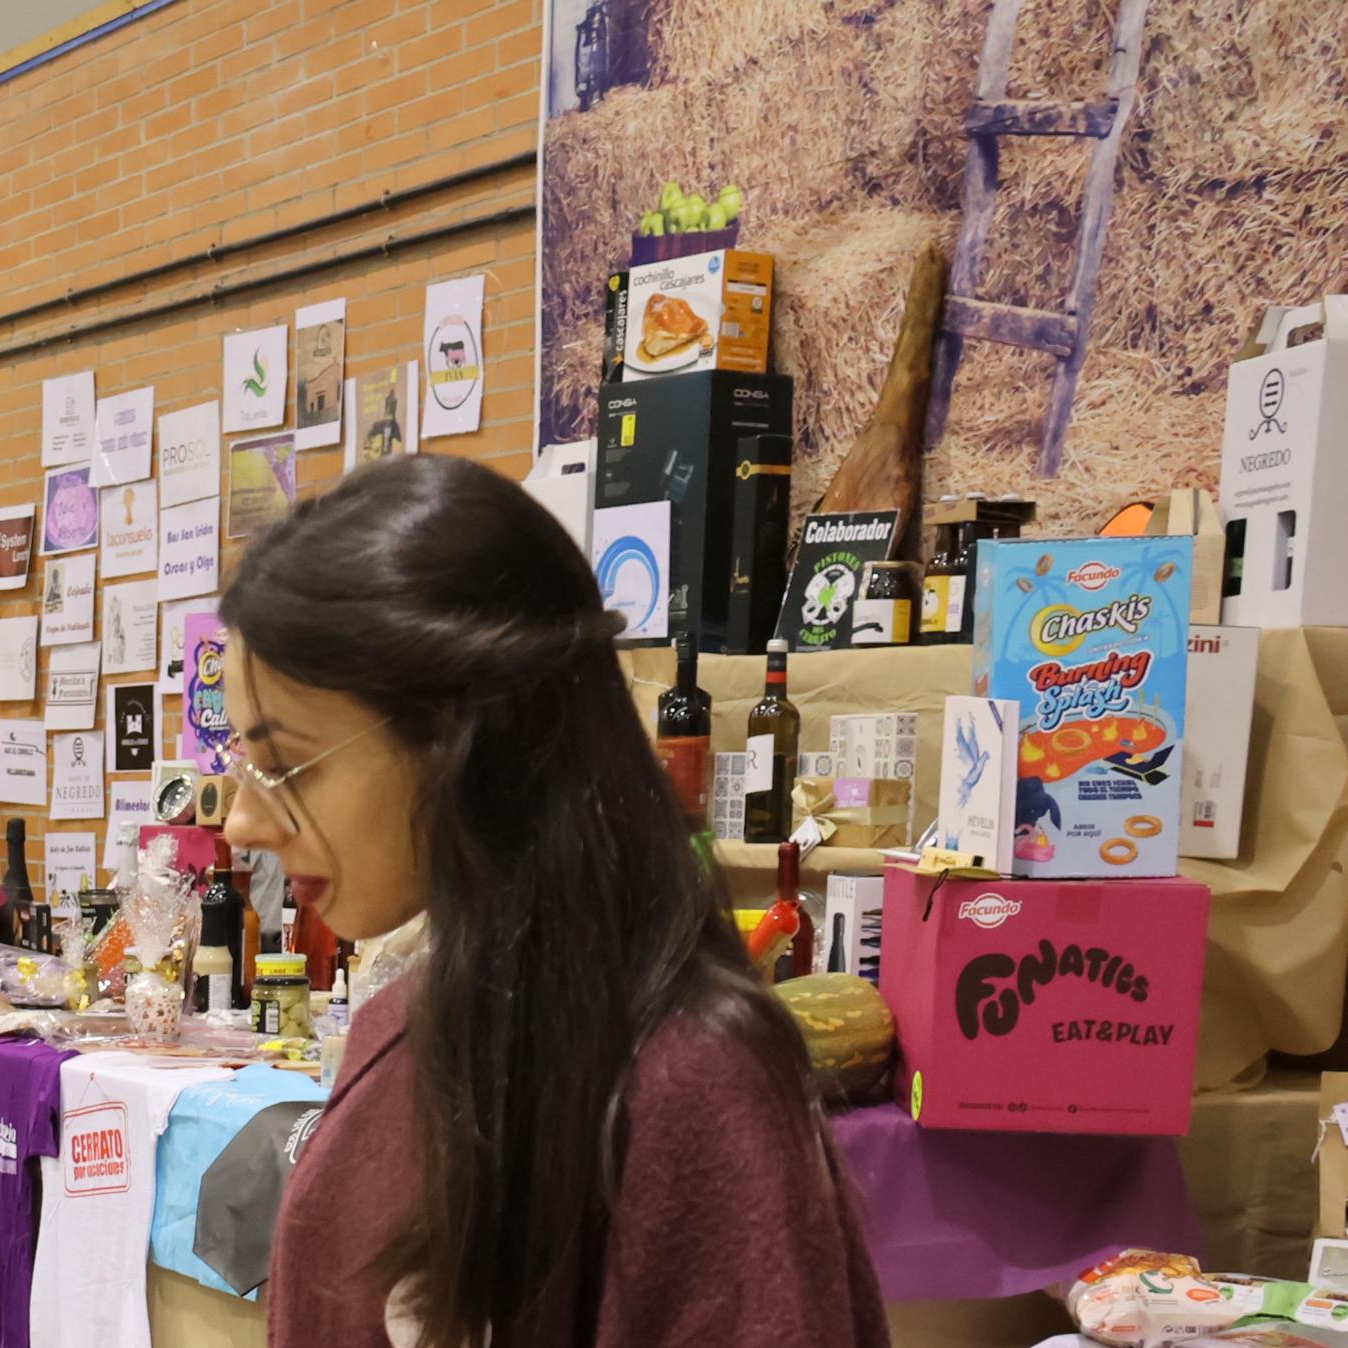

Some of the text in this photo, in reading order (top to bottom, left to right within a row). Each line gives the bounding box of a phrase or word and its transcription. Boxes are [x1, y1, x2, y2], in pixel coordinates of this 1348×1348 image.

[633, 268, 675, 287] cochinillo
[659, 273, 705, 291] cascajares
[616, 289, 628, 351] cascajares
[1239, 448, 1291, 474] NEGREDO
[805, 518, 893, 544] Colaborador
[1066, 564, 1120, 584] Facundo
[1040, 594, 1152, 643] Chaskis
[1029, 651, 1152, 692] Burning
[1038, 679, 1129, 731] Splash
[55, 784, 101, 799] NEGREDO
[959, 902, 1020, 918] Facundo
[1051, 1019, 1175, 1046] EAT&PLAY
[71, 1128, 123, 1163] CERRATO
[73, 1161, 125, 1182] por vacaciones
